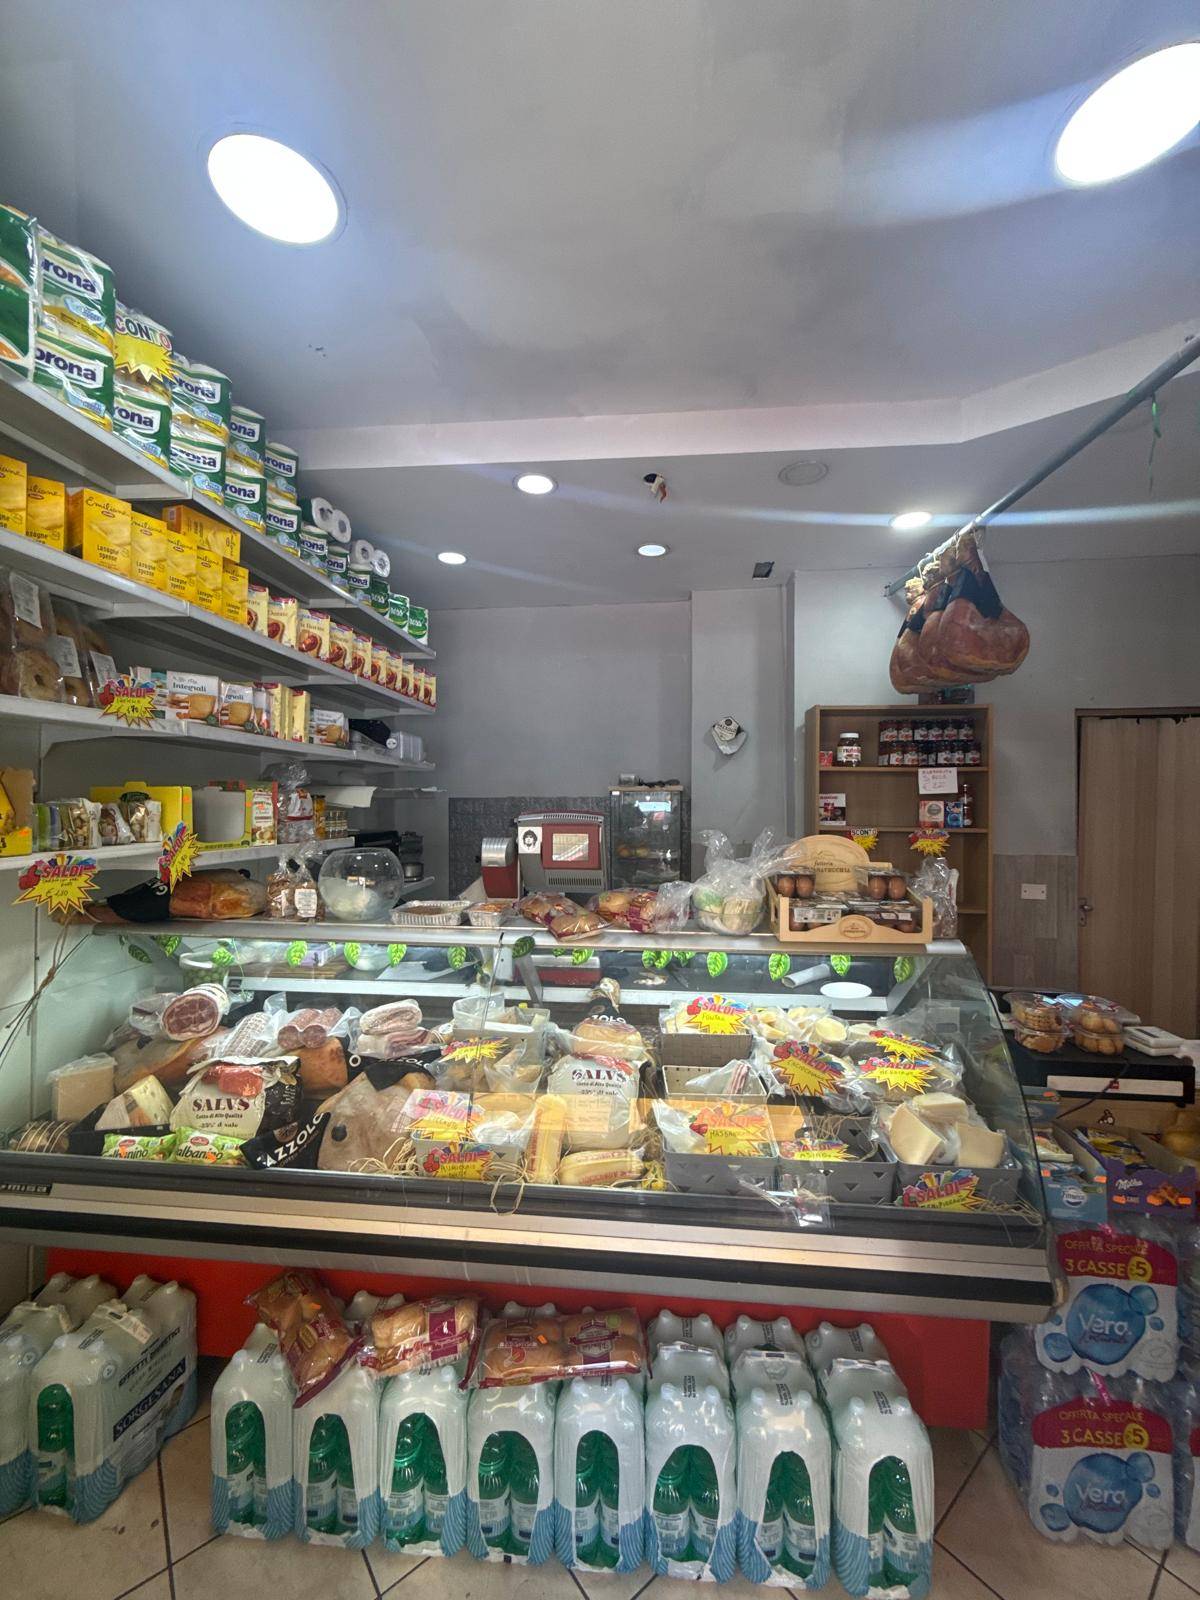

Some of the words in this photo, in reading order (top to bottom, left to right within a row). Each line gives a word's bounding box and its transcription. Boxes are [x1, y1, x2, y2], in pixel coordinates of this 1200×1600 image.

[41, 864, 83, 878] SALDI
[702, 1002, 735, 1015] SALDI
[440, 1152, 477, 1163] SALDI
[917, 1180, 959, 1202] SALDI
[1065, 1258, 1074, 1272] 3
[1077, 1258, 1125, 1276] CASSE
[1079, 1313, 1128, 1335] Vera
[1061, 1430, 1070, 1444] 3
[1073, 1428, 1122, 1446] CASSE
[1075, 1482, 1126, 1505] Vera
